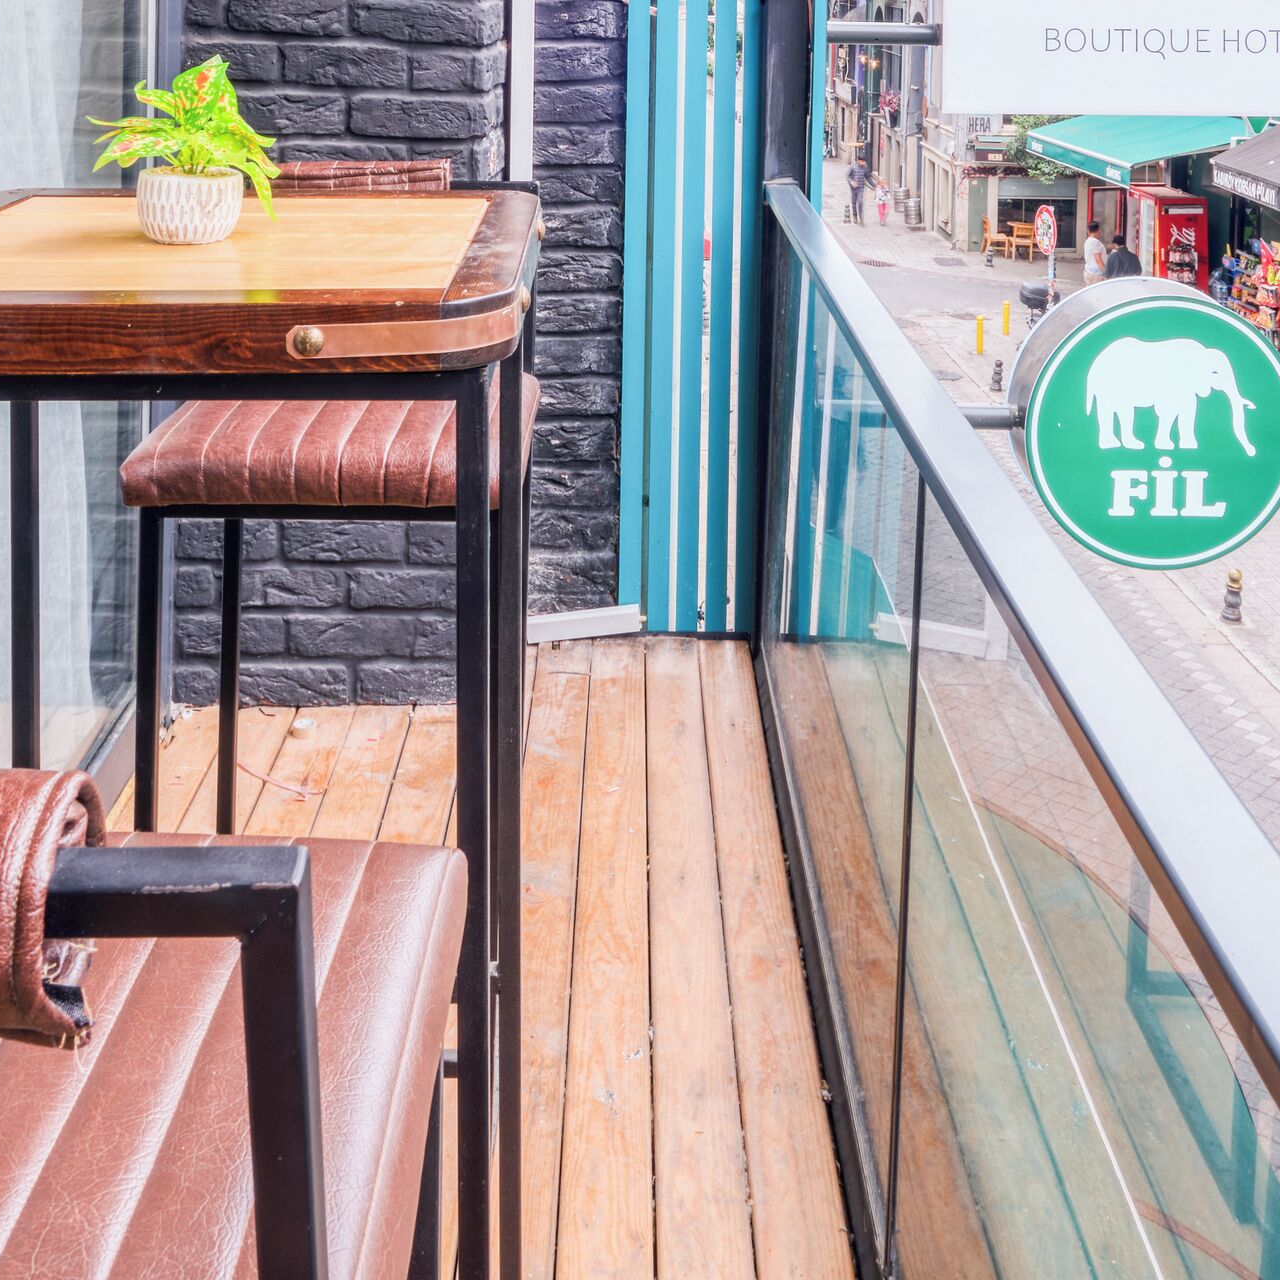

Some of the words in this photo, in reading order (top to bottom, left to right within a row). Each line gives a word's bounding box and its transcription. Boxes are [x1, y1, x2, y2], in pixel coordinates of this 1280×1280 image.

[1044, 27, 1211, 61] BOUTIQUE
[969, 116, 991, 133] HERA
[1107, 455, 1227, 518] FİL
